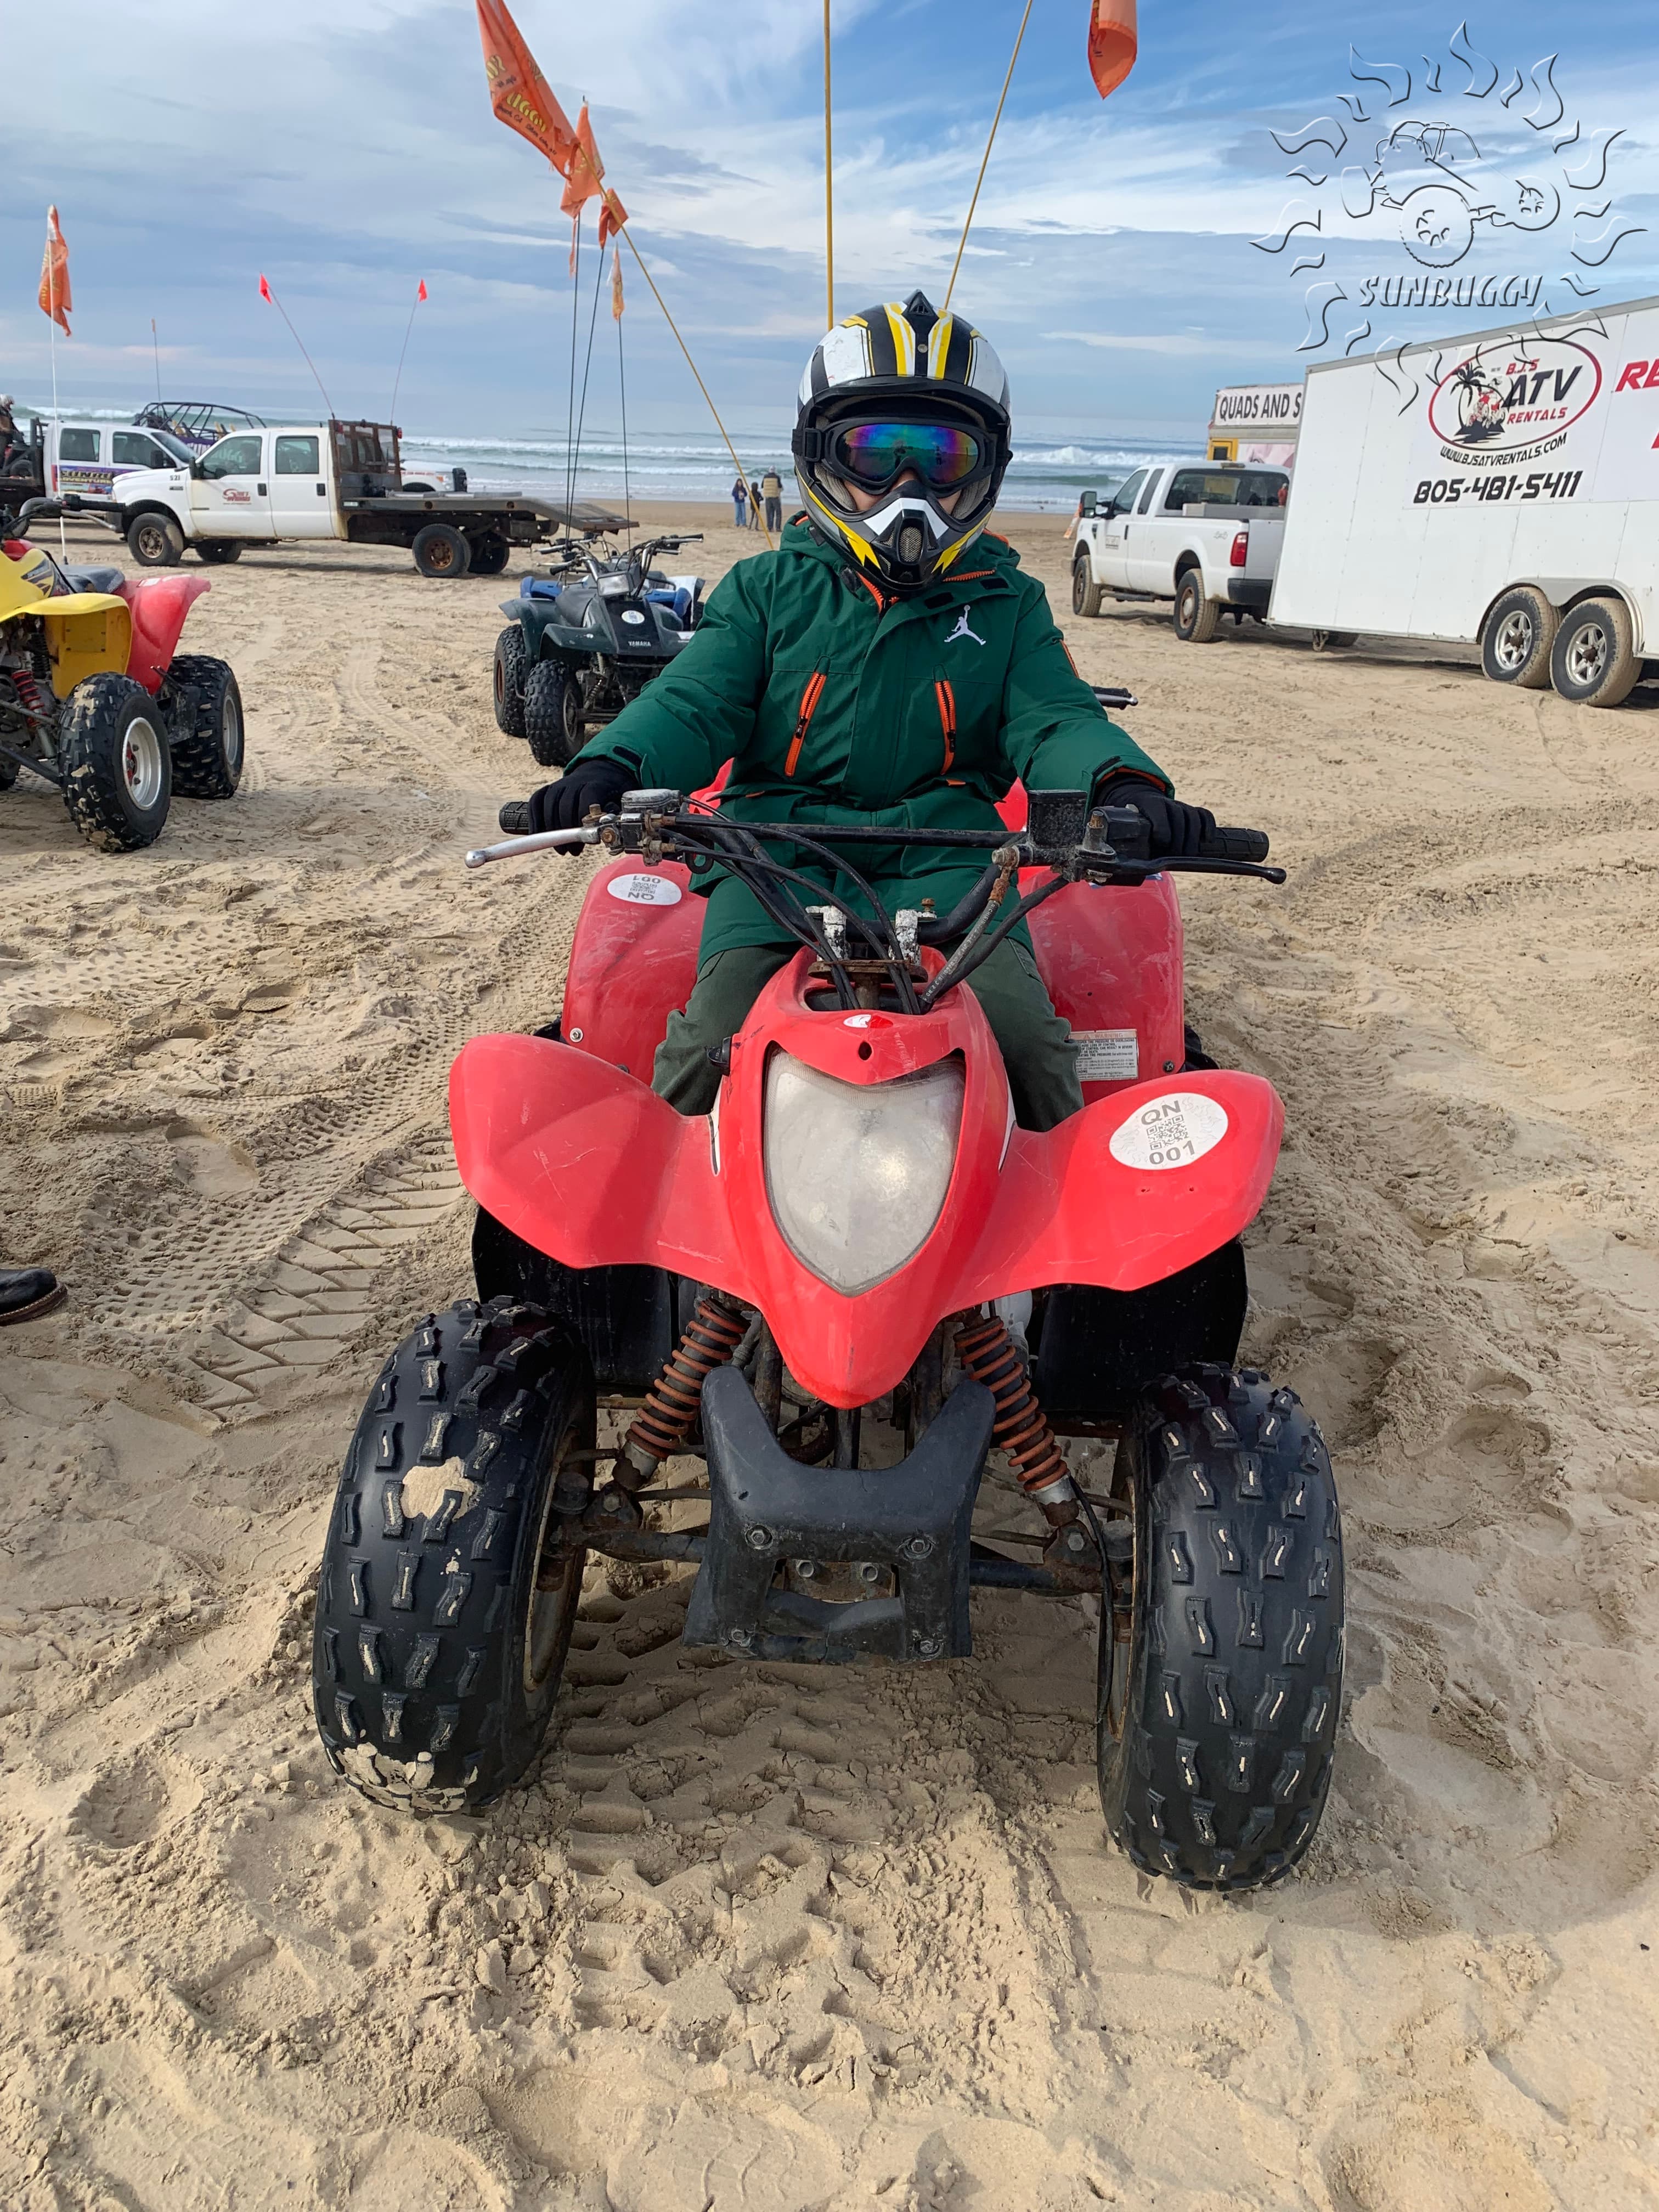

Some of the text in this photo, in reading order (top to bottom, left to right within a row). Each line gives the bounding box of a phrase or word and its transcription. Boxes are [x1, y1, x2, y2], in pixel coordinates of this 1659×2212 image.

[1501, 365, 1583, 408] ATV
[1220, 394, 1260, 421] QUADS
[1261, 393, 1290, 418] AND
[1507, 407, 1567, 425] RENTALS
[1440, 432, 1567, 466] WWW.BJSATVRENTALS.COM
[1413, 471, 1583, 503] 805-481-5411
[633, 875, 661, 884] 001
[627, 891, 654, 901] QN
[1141, 1101, 1181, 1126] QN
[1149, 1140, 1195, 1165] 001
